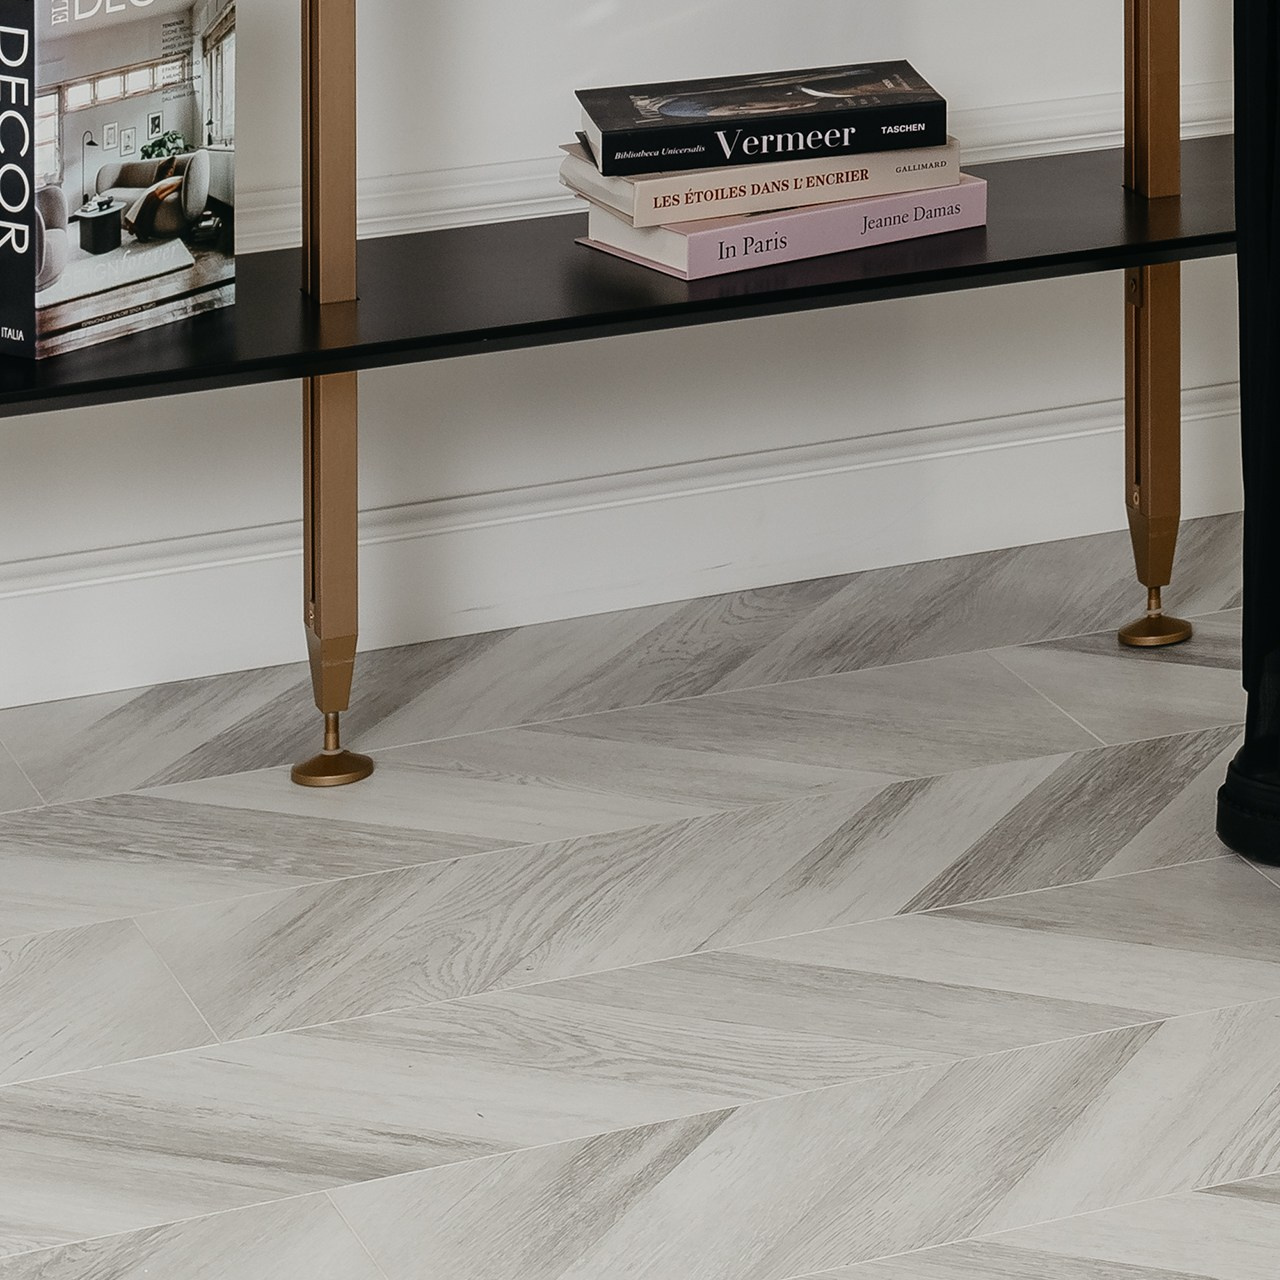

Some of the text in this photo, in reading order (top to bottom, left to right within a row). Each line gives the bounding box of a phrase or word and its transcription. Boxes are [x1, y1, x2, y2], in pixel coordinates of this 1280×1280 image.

[714, 125, 856, 161] Vermeer
[881, 123, 926, 135] TASCHEN
[653, 193, 680, 210] LES
[684, 185, 747, 205] ÉTOILES
[751, 179, 790, 196] DANS
[895, 160, 948, 174] GALLIMARD
[718, 202, 962, 260] In Paris Jeanne Damas
[1, 326, 25, 341] ITALIA
